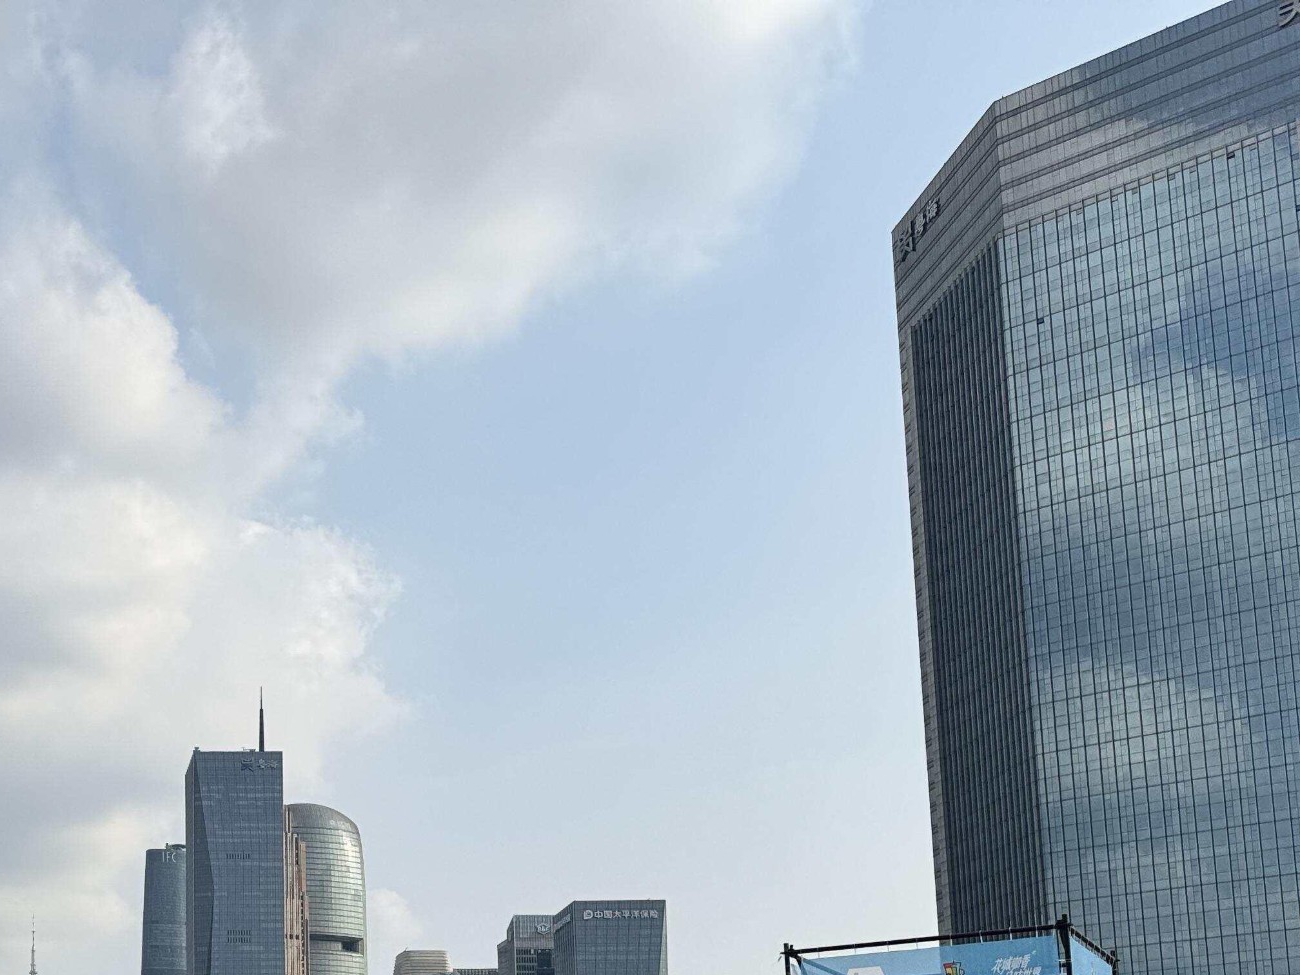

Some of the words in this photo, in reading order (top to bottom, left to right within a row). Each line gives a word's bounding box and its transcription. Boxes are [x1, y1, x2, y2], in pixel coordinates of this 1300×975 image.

[162, 851, 177, 863] IFC
[593, 909, 659, 920] 中国太平洋保险
